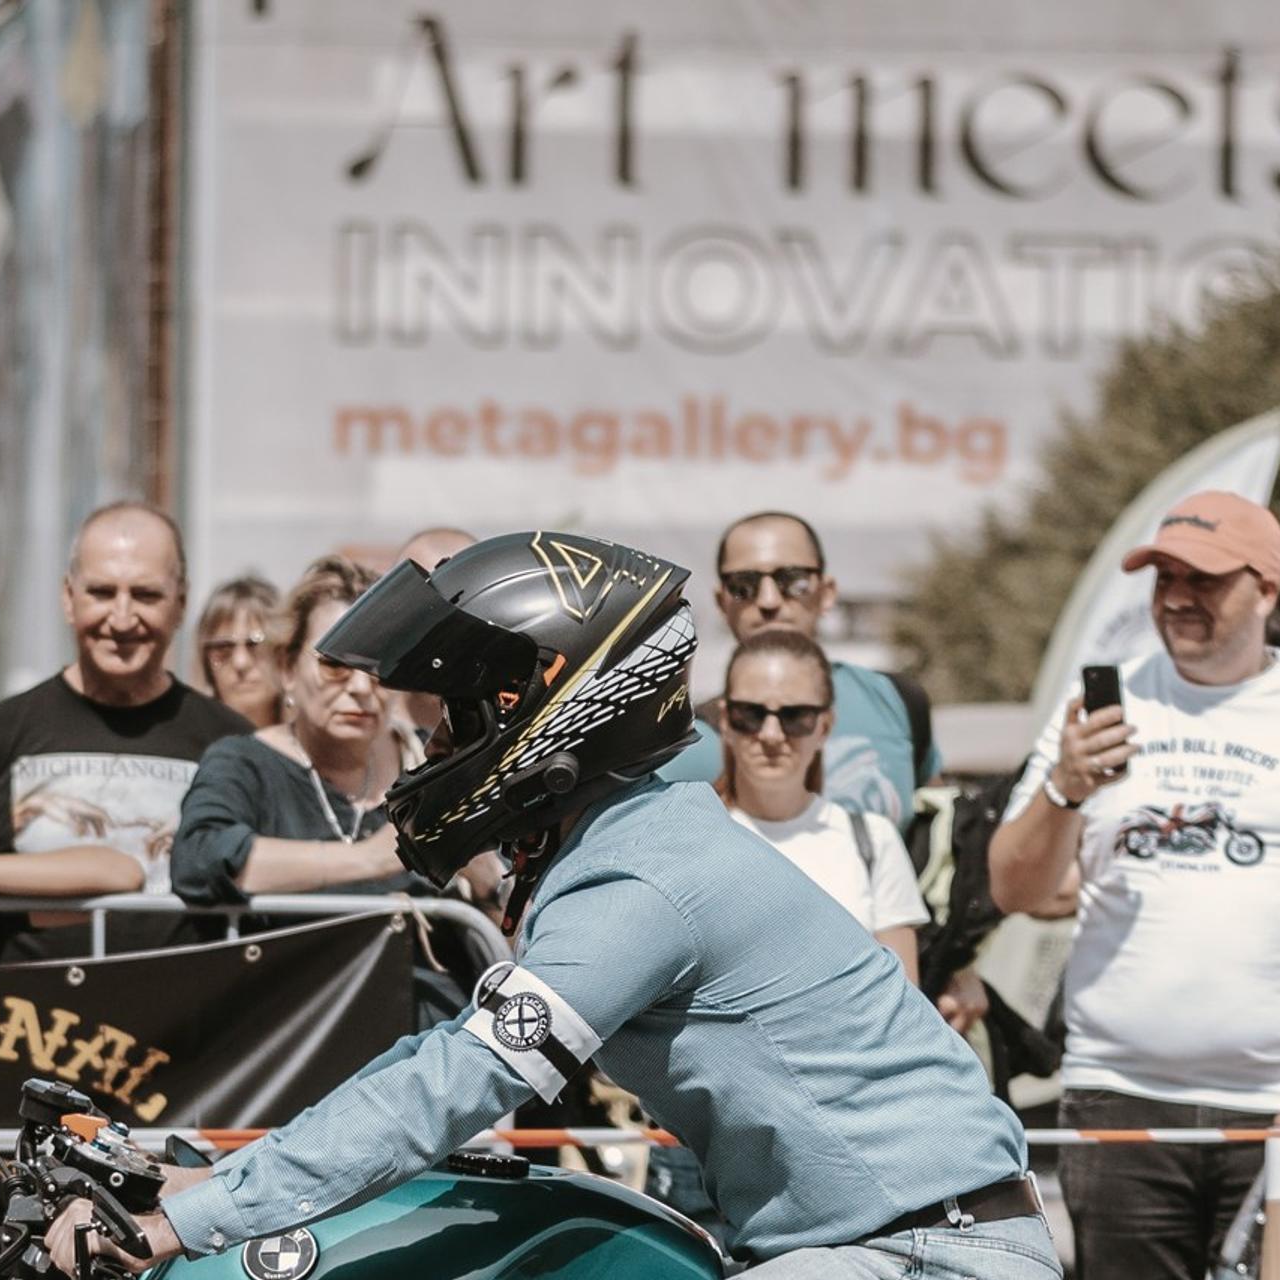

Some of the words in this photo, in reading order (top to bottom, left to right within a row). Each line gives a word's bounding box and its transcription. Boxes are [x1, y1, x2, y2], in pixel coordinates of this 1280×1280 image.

[342, 12, 642, 192] Art
[332, 394, 1010, 484] metagallery.bg
[1183, 737, 1217, 756] BULL
[1224, 741, 1280, 771] RACERS
[533, 1017, 548, 1041] CLUB
